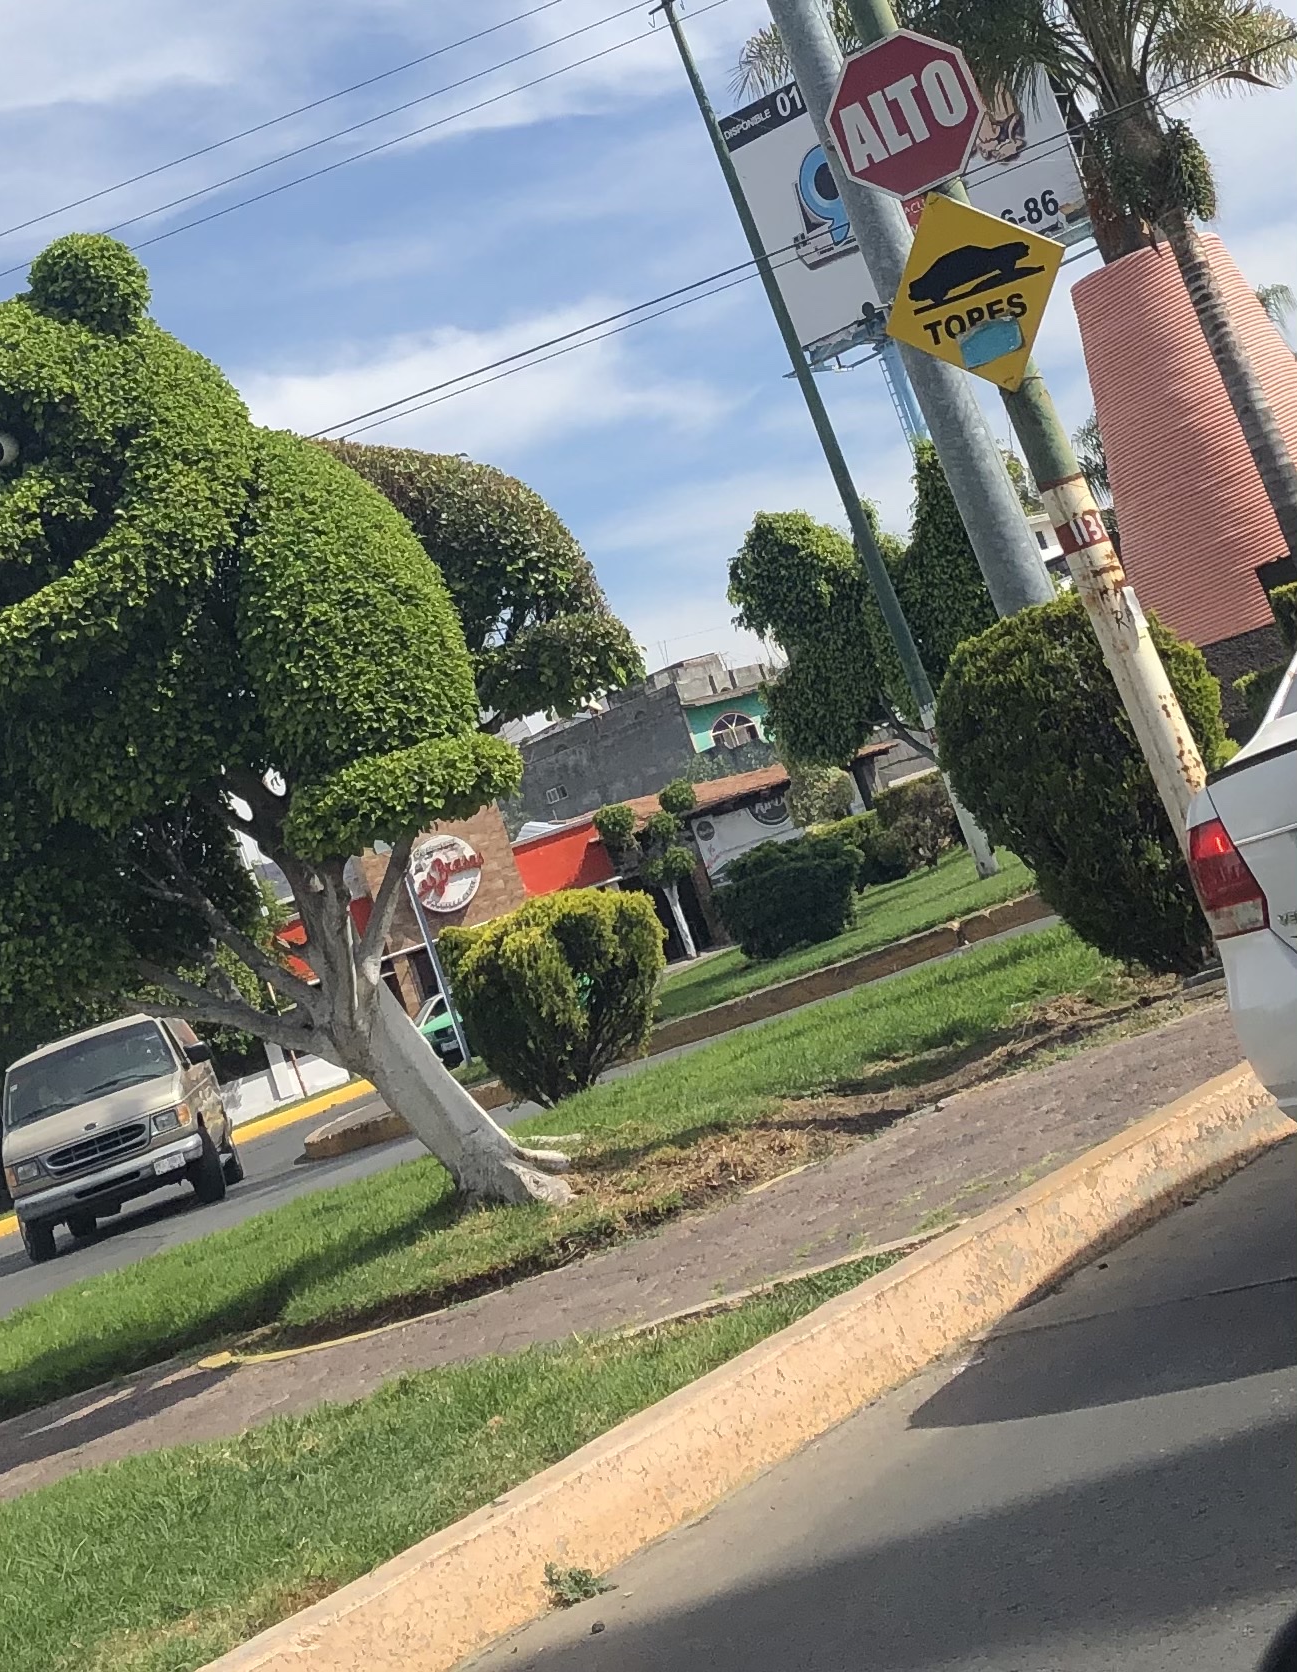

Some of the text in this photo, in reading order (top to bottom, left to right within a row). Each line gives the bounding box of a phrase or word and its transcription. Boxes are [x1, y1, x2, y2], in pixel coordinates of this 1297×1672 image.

[723, 85, 803, 140] DISPONIBLE 01
[839, 59, 969, 173] ALTO
[922, 292, 1028, 346] TOPES
